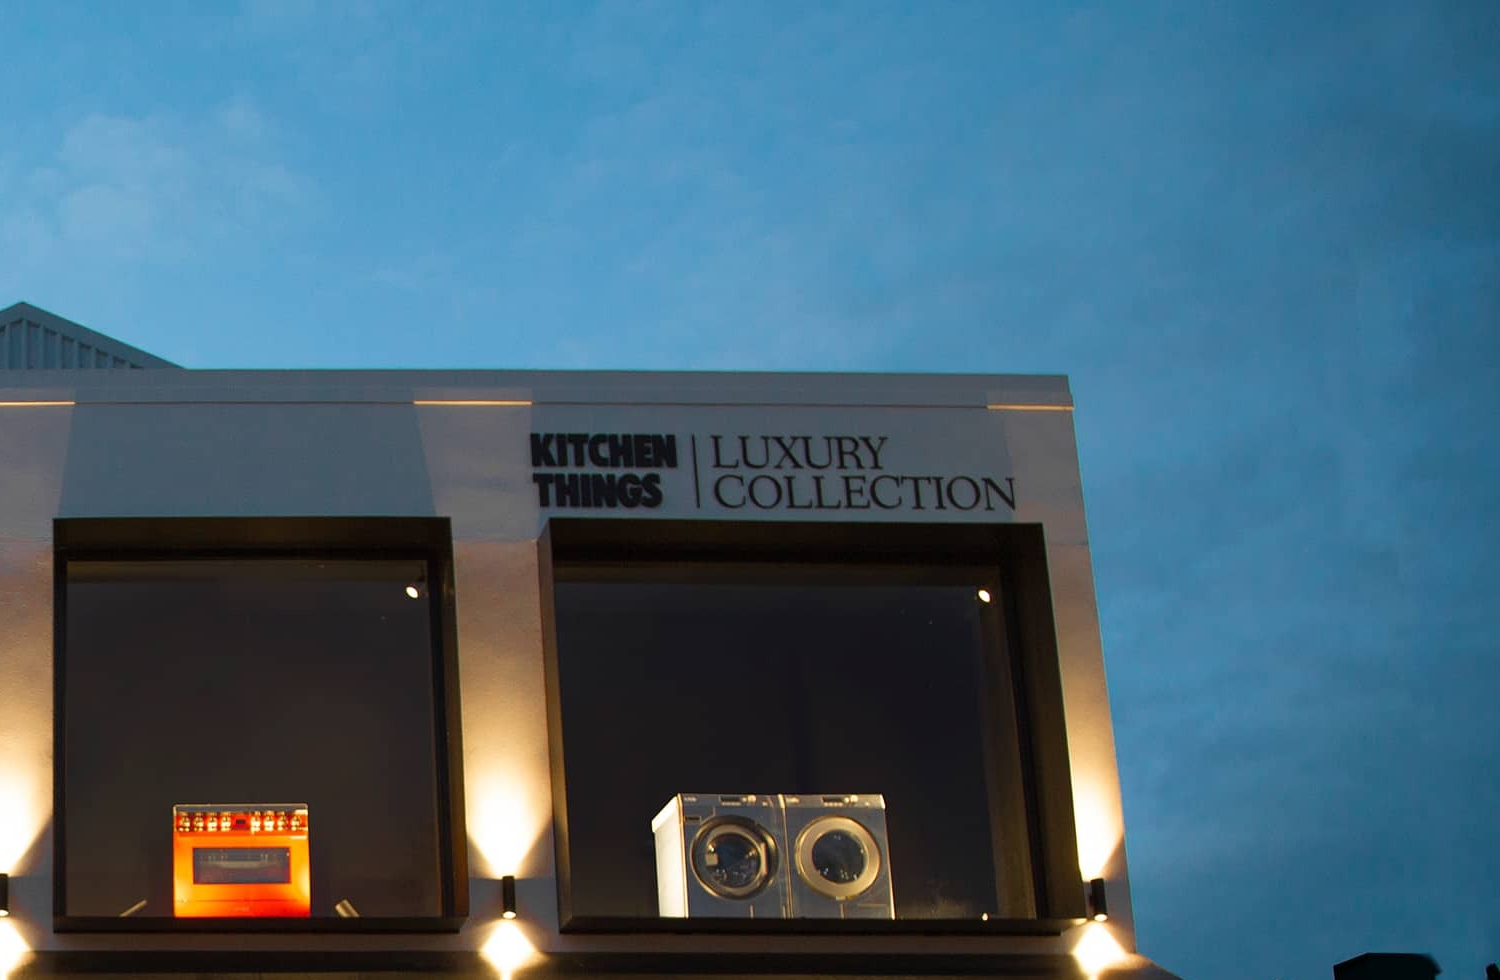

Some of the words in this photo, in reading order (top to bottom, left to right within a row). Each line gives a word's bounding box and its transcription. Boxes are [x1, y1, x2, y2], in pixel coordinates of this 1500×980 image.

[530, 433, 678, 468] KITCHEN
[711, 434, 889, 470] LUXURY
[533, 473, 663, 508] THINGS
[713, 475, 1017, 511] COLLECTION
